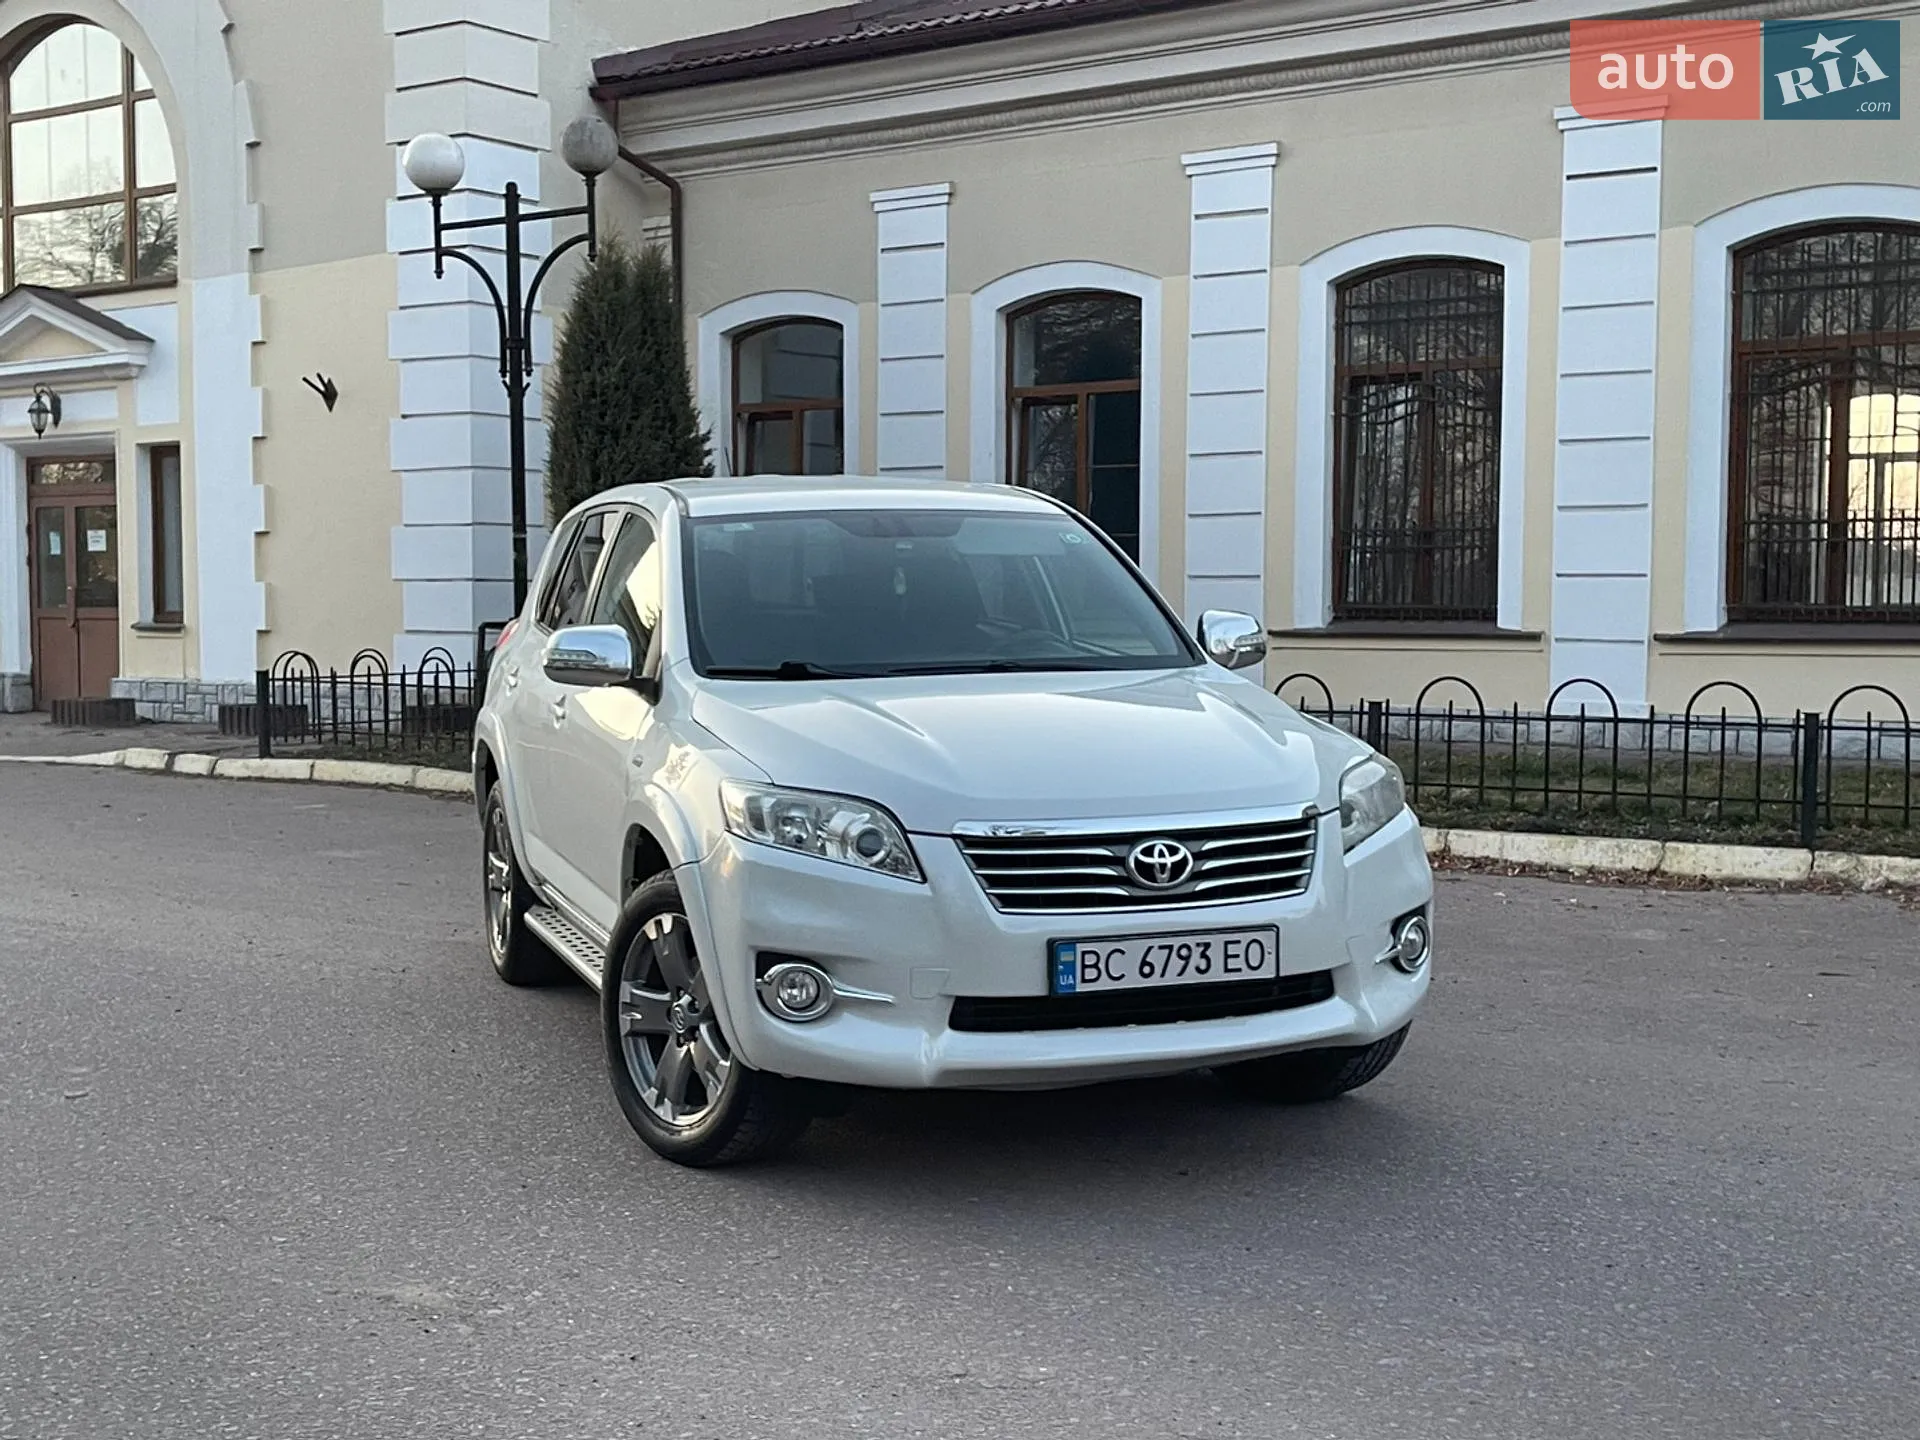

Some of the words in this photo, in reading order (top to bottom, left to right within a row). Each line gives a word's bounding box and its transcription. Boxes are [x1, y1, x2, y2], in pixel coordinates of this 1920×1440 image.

[1080, 948, 1126, 984] BC
[1138, 941, 1212, 979] 6793
[1223, 938, 1265, 974] EO
[1059, 975, 1075, 986] UA
